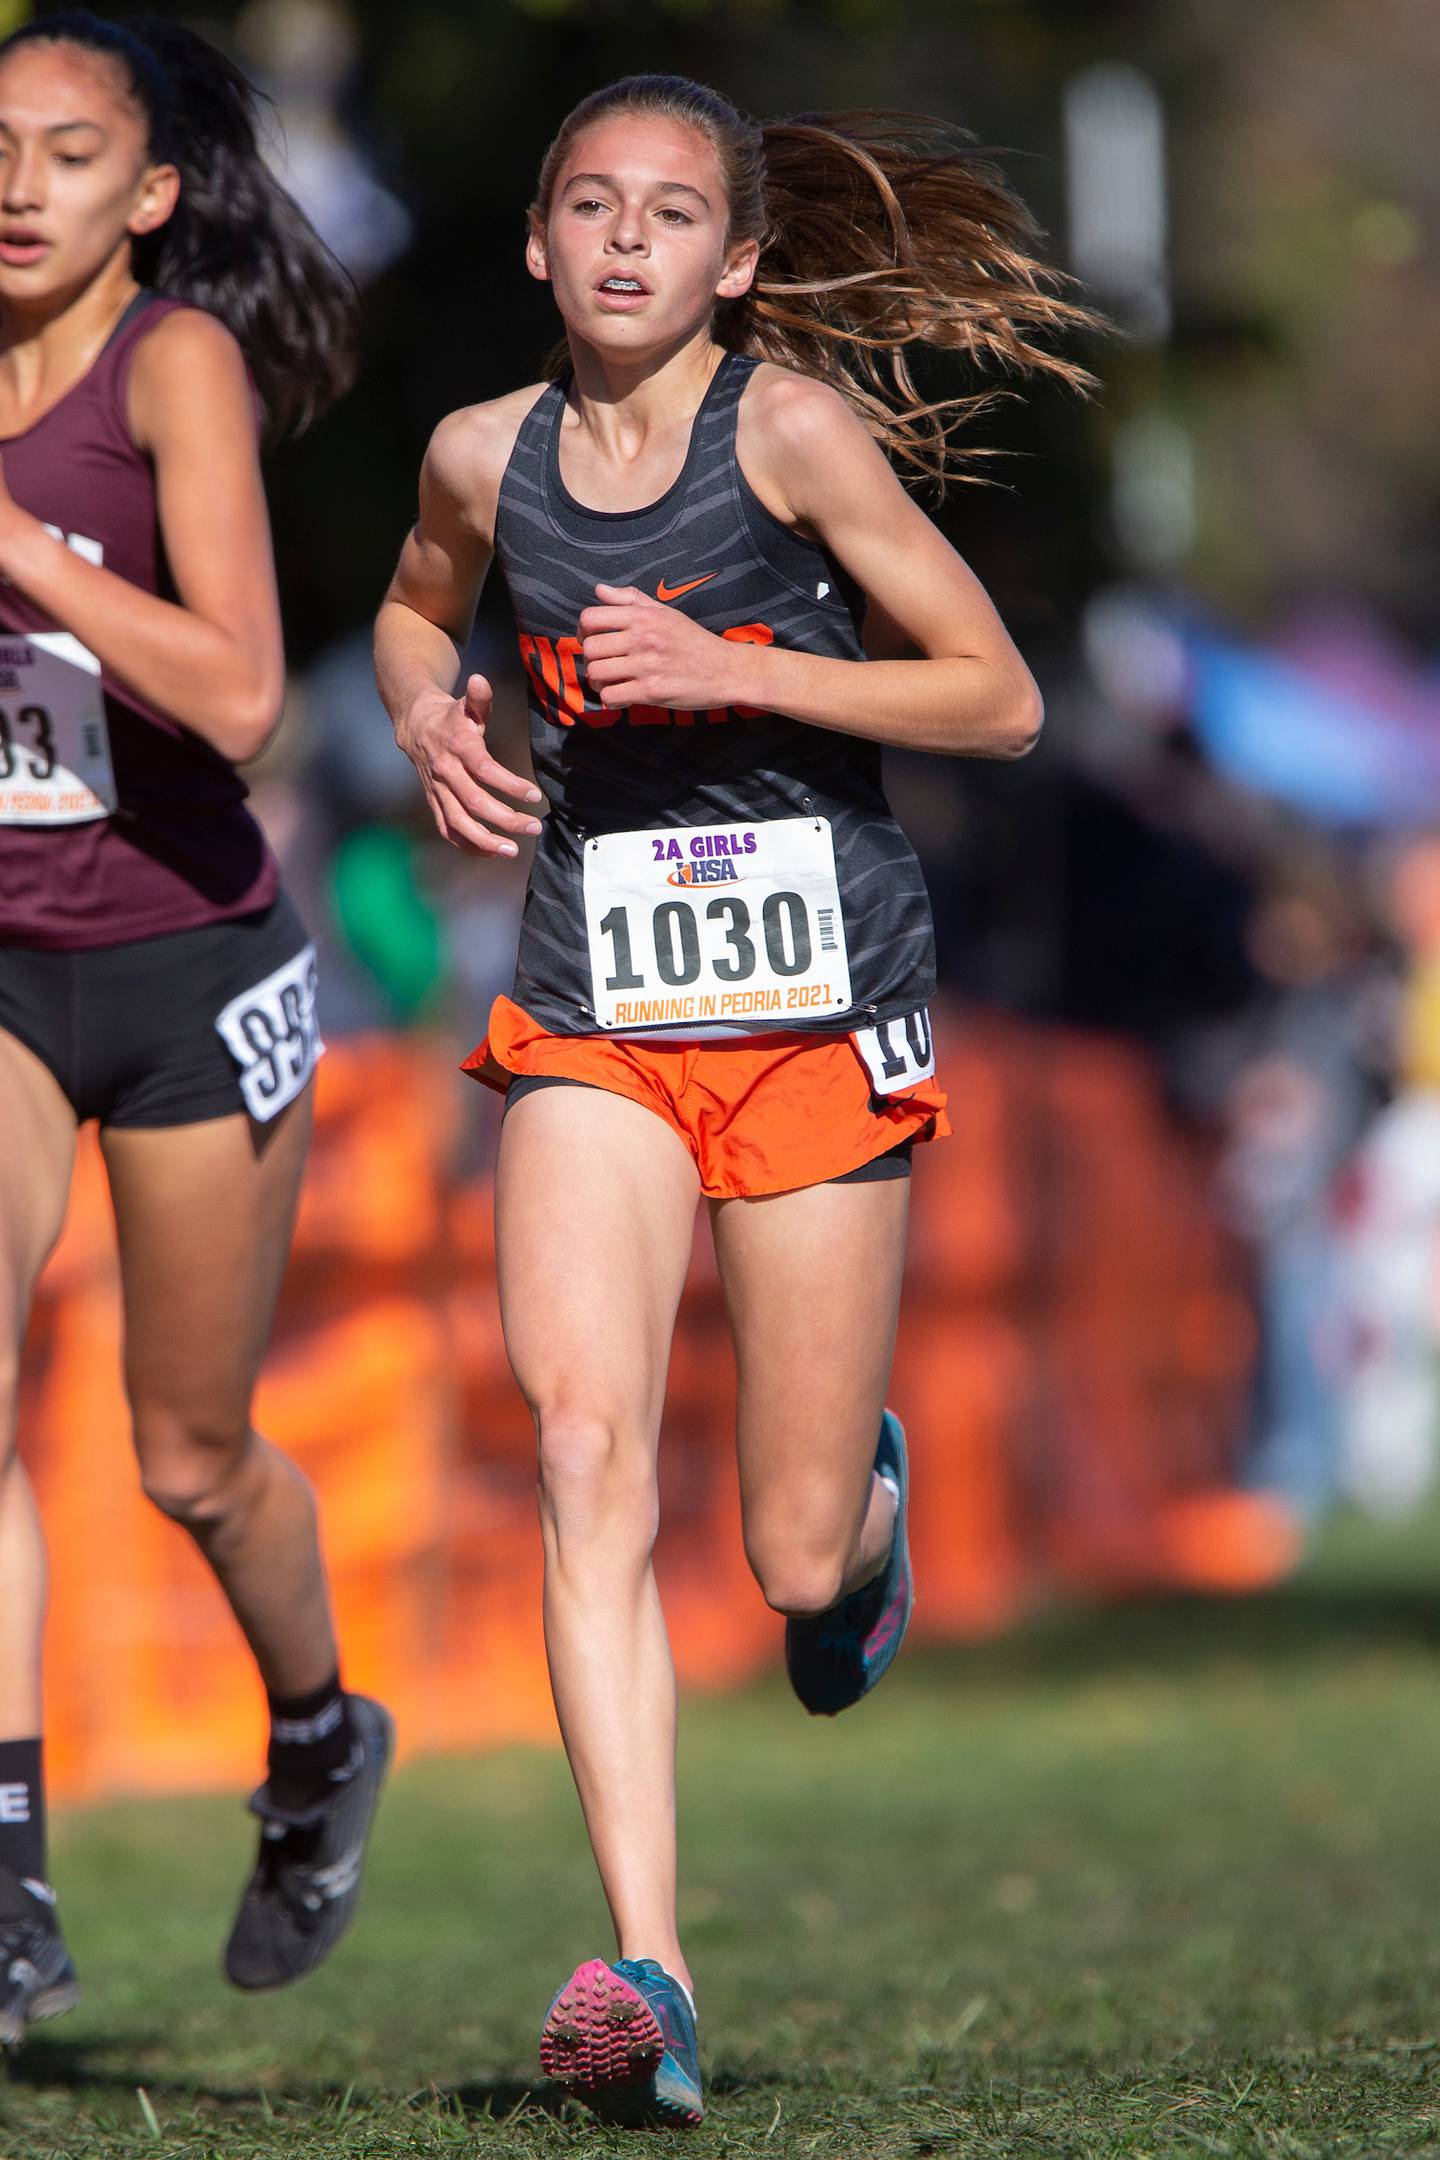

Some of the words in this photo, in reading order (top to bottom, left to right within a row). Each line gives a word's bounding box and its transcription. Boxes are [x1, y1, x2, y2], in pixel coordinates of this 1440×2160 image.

[652, 839, 683, 861] 2A
[690, 832, 757, 858] GIRLS
[676, 859, 738, 884] IHSA
[600, 891, 812, 990] 1030
[615, 996, 694, 1024] RUNNING
[698, 995, 716, 1017] IN
[720, 988, 782, 1015] PEORIA
[787, 983, 833, 1009] 2021
[240, 959, 317, 1098] 99
